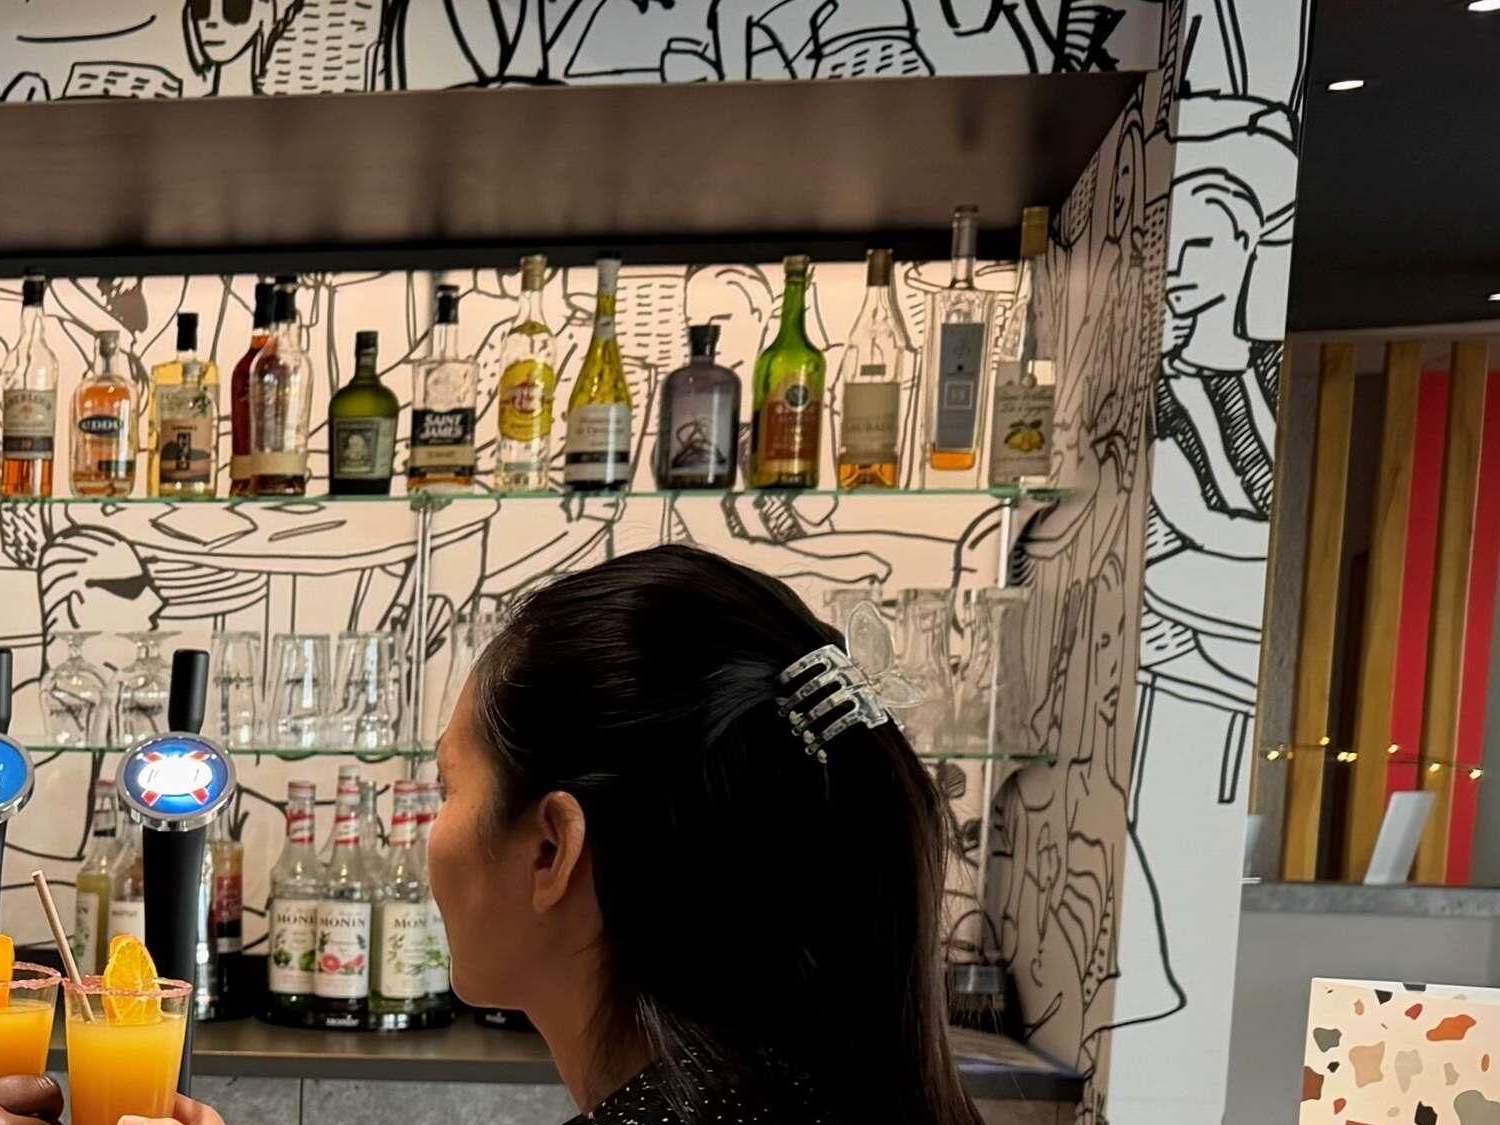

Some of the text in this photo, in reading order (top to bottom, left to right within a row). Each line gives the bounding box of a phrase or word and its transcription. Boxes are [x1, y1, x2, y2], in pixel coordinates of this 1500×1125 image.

[420, 422, 463, 439] JAMES
[319, 915, 366, 928] MONIN
[394, 918, 427, 928] MON
